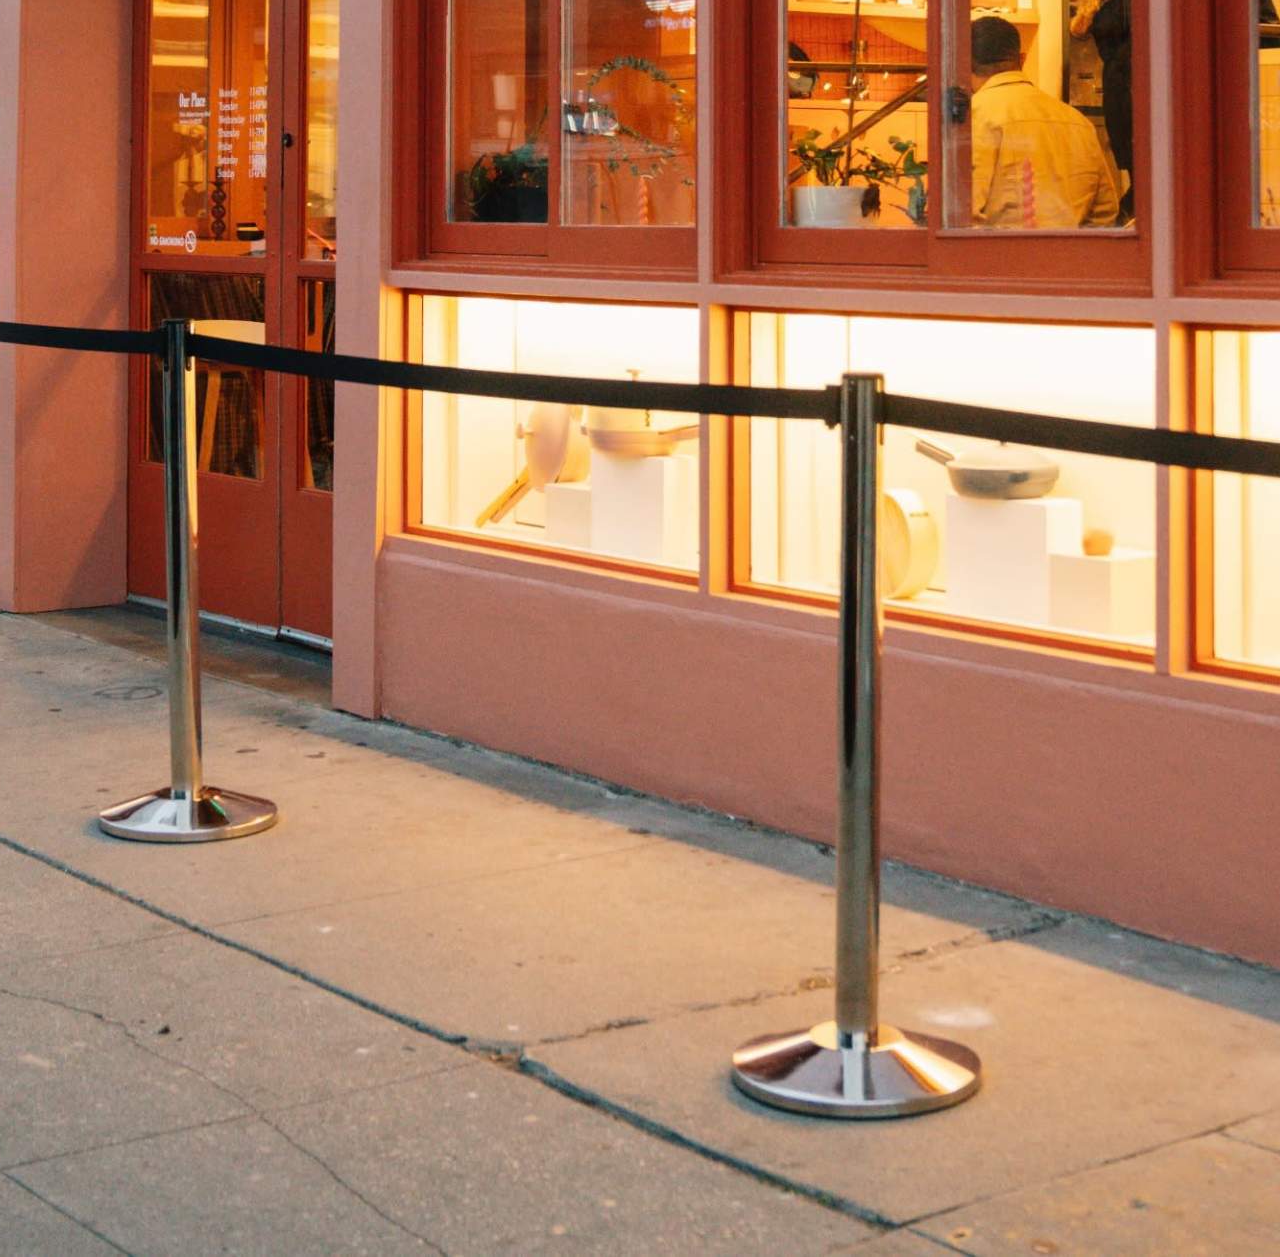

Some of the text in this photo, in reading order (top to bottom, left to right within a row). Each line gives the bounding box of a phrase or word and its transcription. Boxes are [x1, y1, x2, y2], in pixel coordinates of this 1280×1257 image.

[179, 92, 207, 108] Our Place
[150, 236, 185, 247] NO SMOKING
